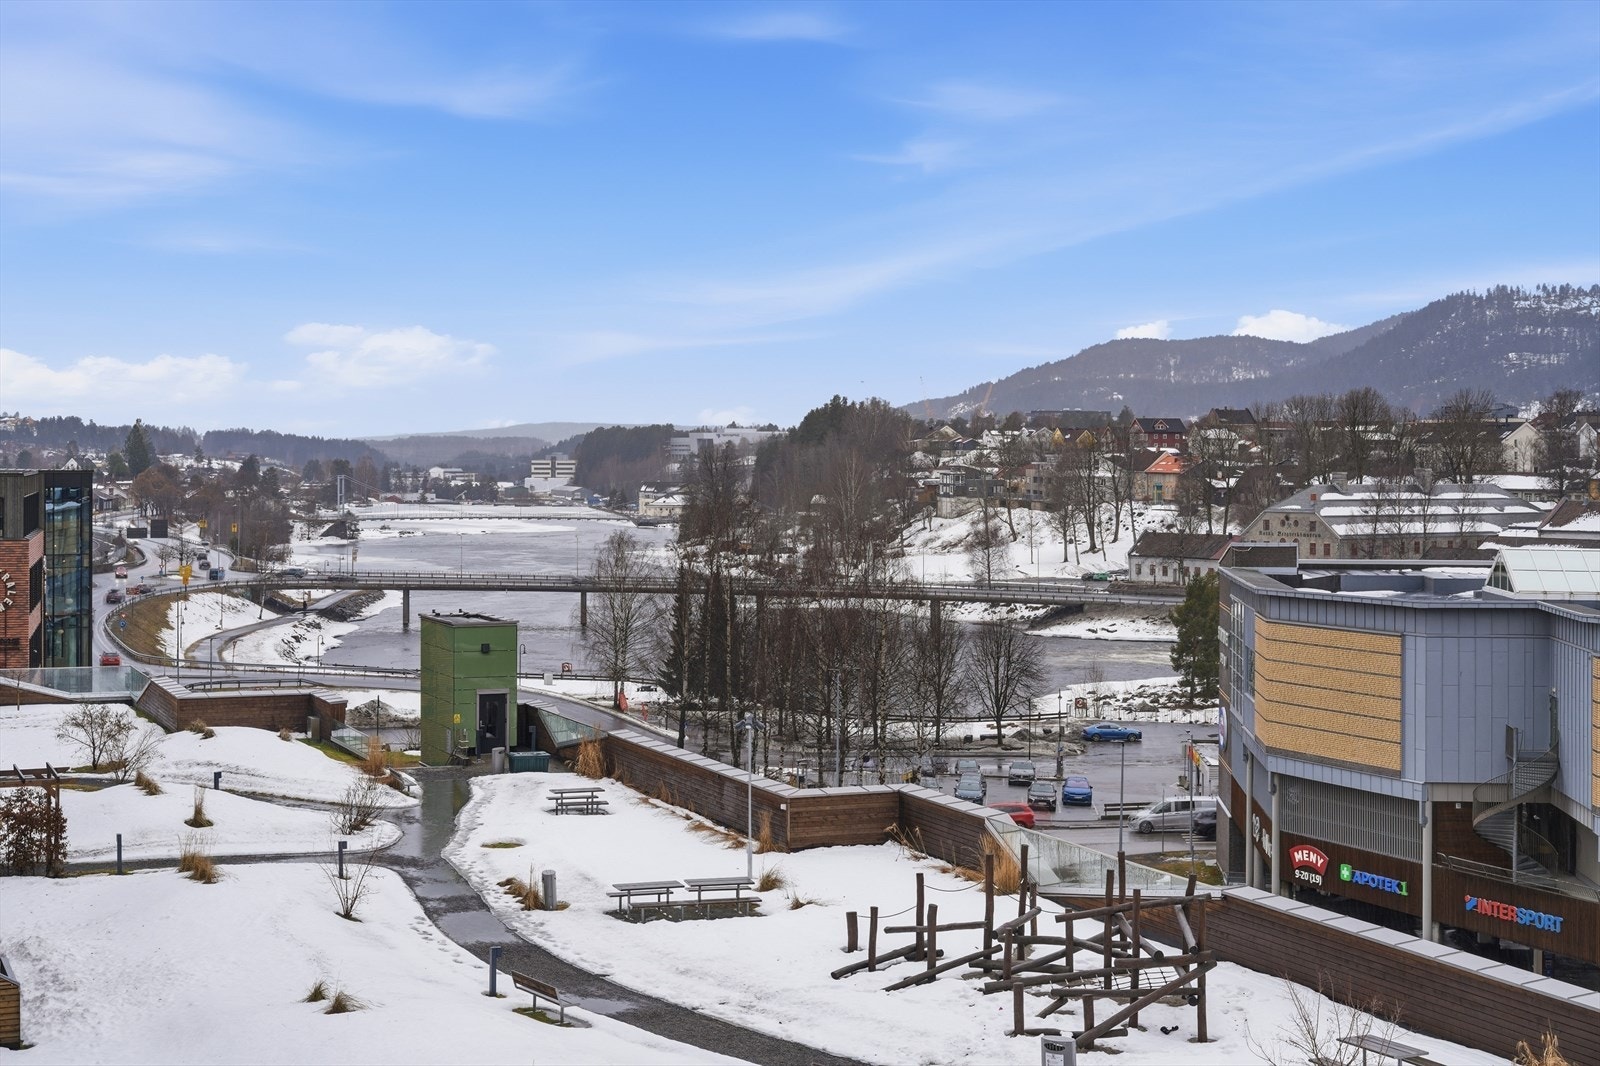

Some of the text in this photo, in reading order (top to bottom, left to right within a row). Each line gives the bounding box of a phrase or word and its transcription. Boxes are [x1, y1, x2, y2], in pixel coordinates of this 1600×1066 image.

[1294, 849, 1325, 868] MENY
[1294, 869, 1322, 886] 9-20 (19)
[1477, 897, 1563, 933] INTERSPORT
